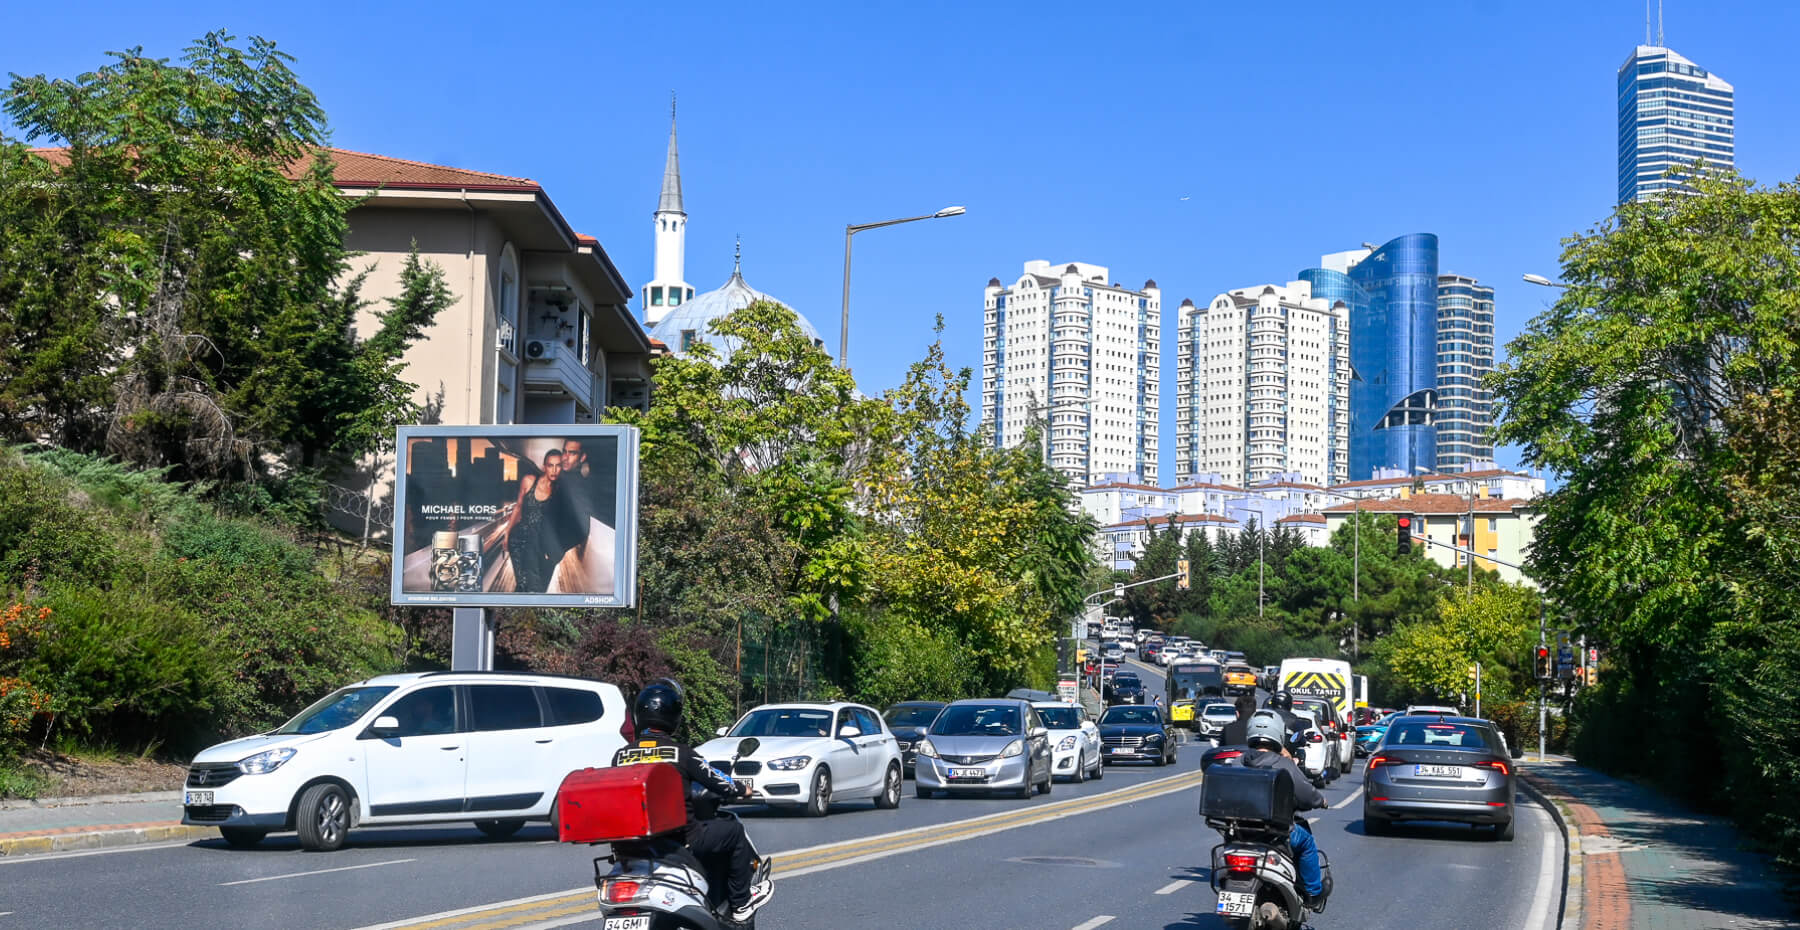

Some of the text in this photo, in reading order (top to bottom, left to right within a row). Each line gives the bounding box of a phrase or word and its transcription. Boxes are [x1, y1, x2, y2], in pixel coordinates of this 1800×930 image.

[421, 505, 497, 514] MICHAEL KORS
[1432, 766, 1445, 774] KAS
[1448, 767, 1460, 775] 551
[1220, 892, 1254, 903] 34 EE
[1225, 902, 1246, 912] 1571
[607, 920, 620, 930] 34
